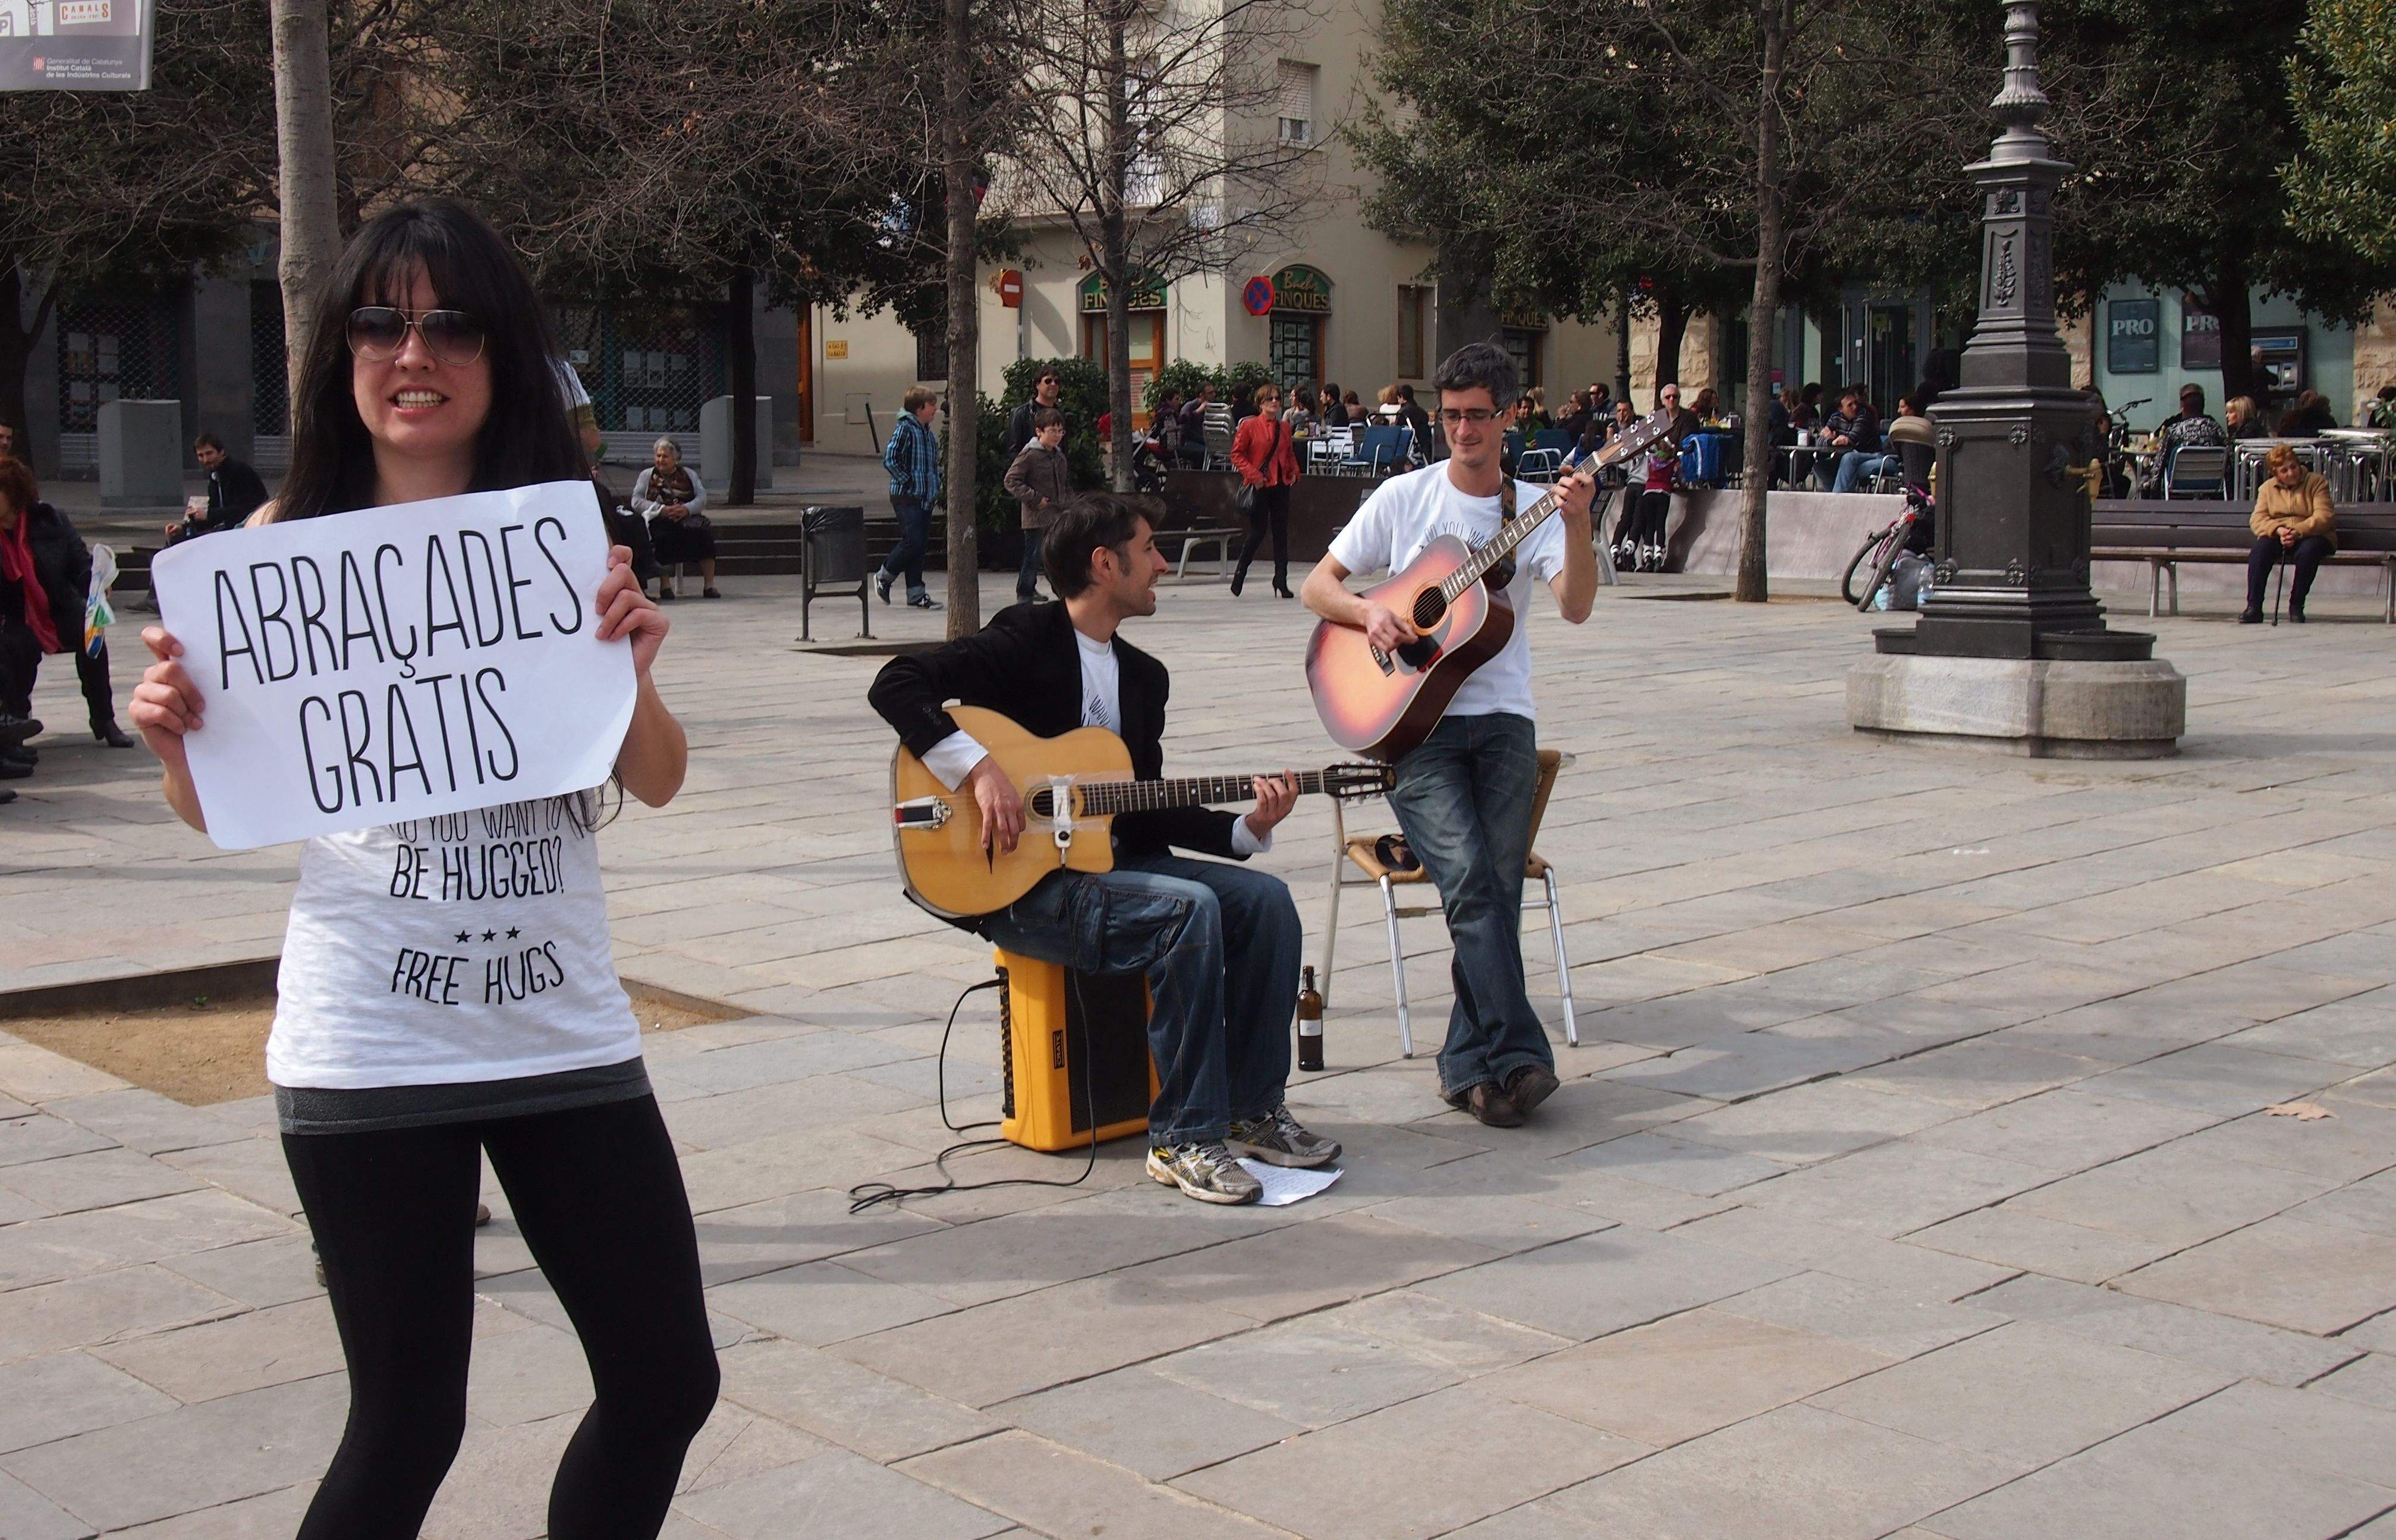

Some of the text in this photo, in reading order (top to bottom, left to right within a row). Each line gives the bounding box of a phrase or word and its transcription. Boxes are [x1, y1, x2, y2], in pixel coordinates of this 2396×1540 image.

[62, 3, 109, 20] CANALS
[1084, 290, 1161, 308] FINUES
[1274, 290, 1330, 308] FINQUES
[2112, 319, 2154, 336] PRO
[1467, 527, 1489, 550] WA
[215, 517, 581, 690] ABRAÇADES
[299, 667, 518, 814] GRATIS
[429, 811, 468, 842] YOU
[481, 799, 536, 839] WANT
[543, 797, 562, 832] TO
[390, 836, 564, 901] BE HUGGED?
[391, 940, 564, 1005] FREE HUGS
